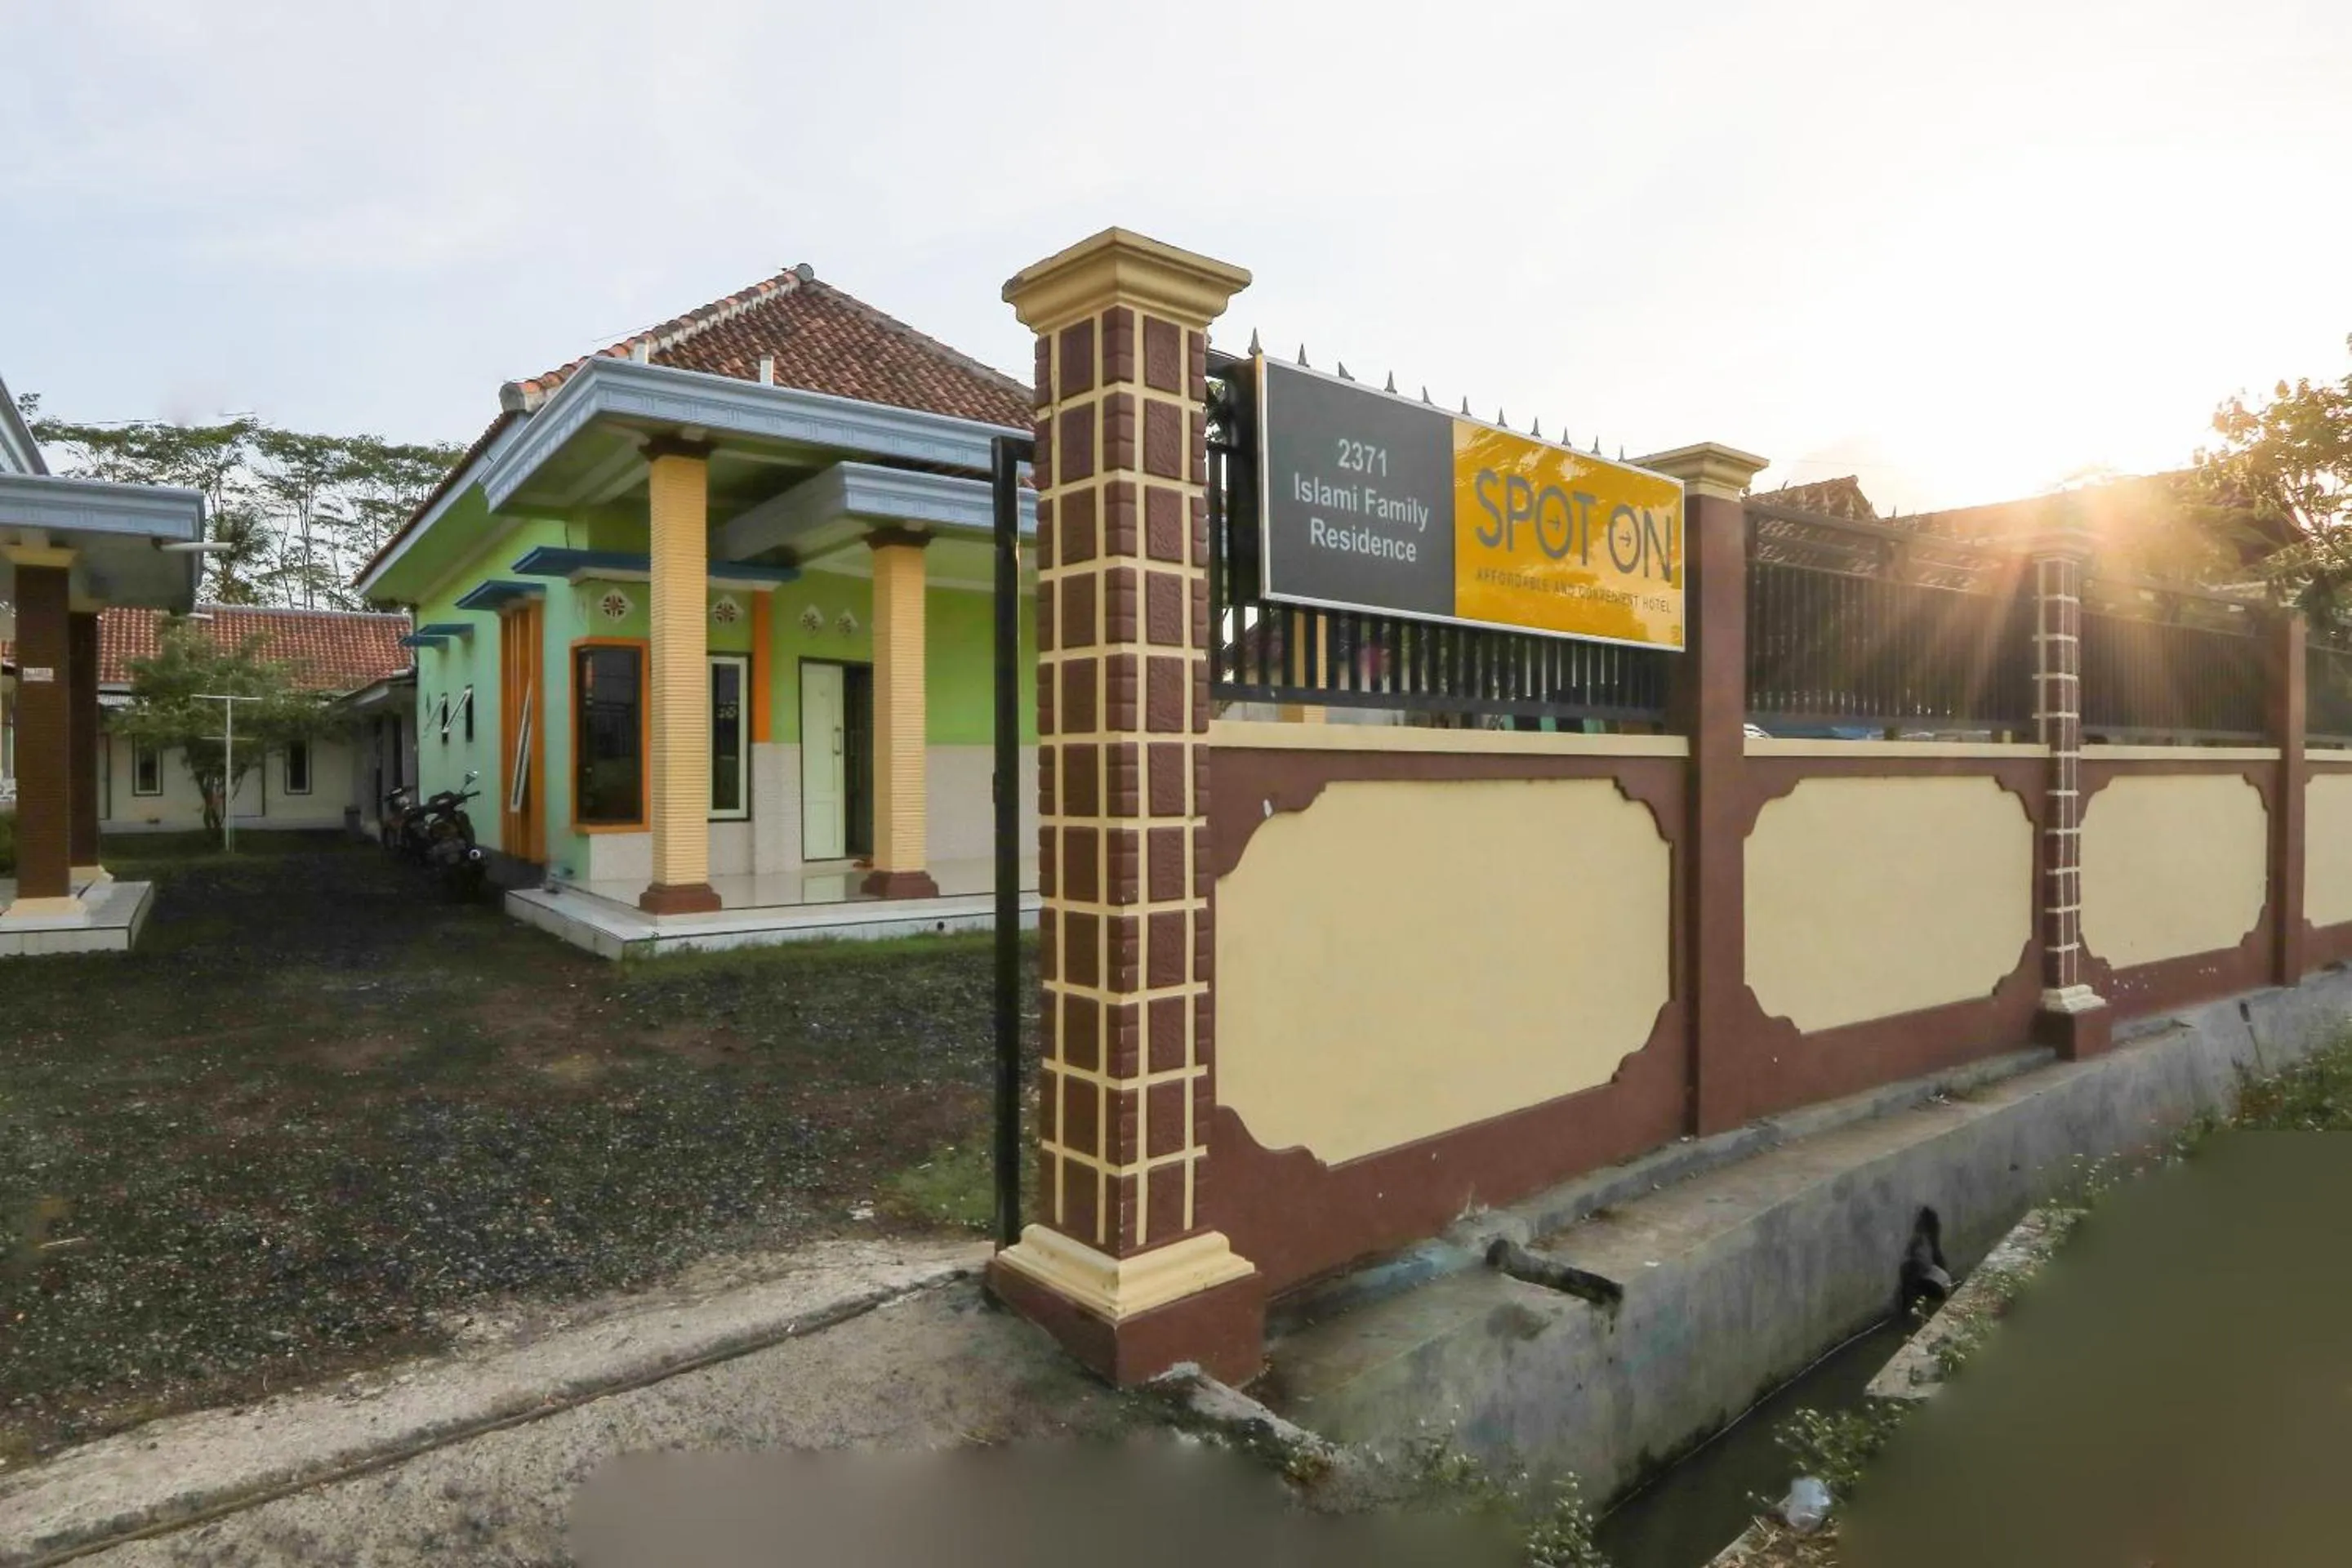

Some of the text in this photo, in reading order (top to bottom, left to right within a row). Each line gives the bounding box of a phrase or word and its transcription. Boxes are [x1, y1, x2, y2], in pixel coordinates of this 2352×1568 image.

[1338, 439, 1387, 477] 2371
[1294, 471, 1429, 532] Islami Family
[1475, 467, 1672, 582] SPOT ON
[1310, 516, 1417, 563] Residence
[1642, 597, 1671, 613] HOTEL
